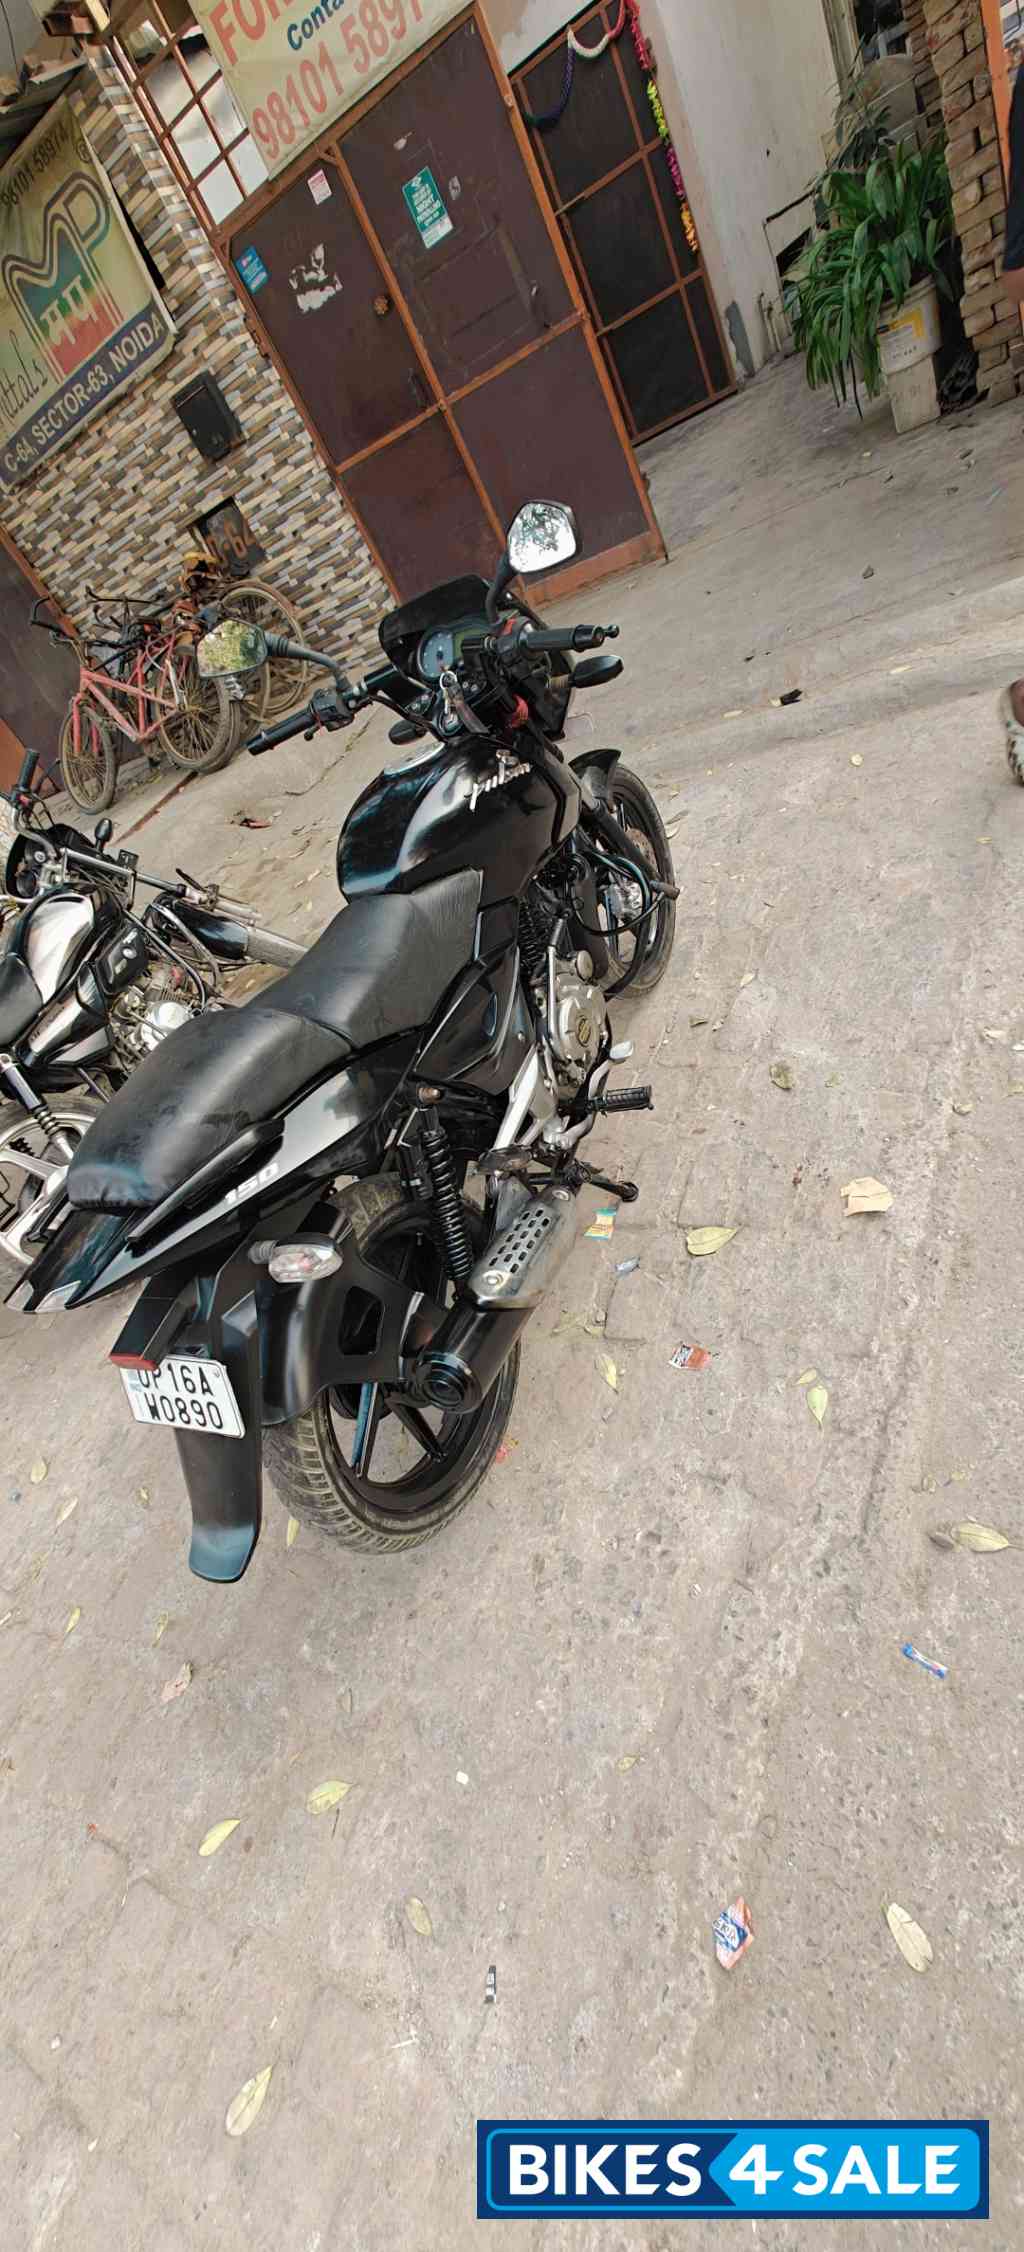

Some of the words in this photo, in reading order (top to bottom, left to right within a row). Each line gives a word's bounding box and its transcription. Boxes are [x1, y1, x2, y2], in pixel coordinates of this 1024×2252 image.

[252, 41, 344, 160] 98101
[31, 364, 116, 446] SECTOR-63,
[108, 311, 165, 374] NOIDA
[225, 1162, 279, 1204] 150
[144, 1393, 224, 1430] W0890
